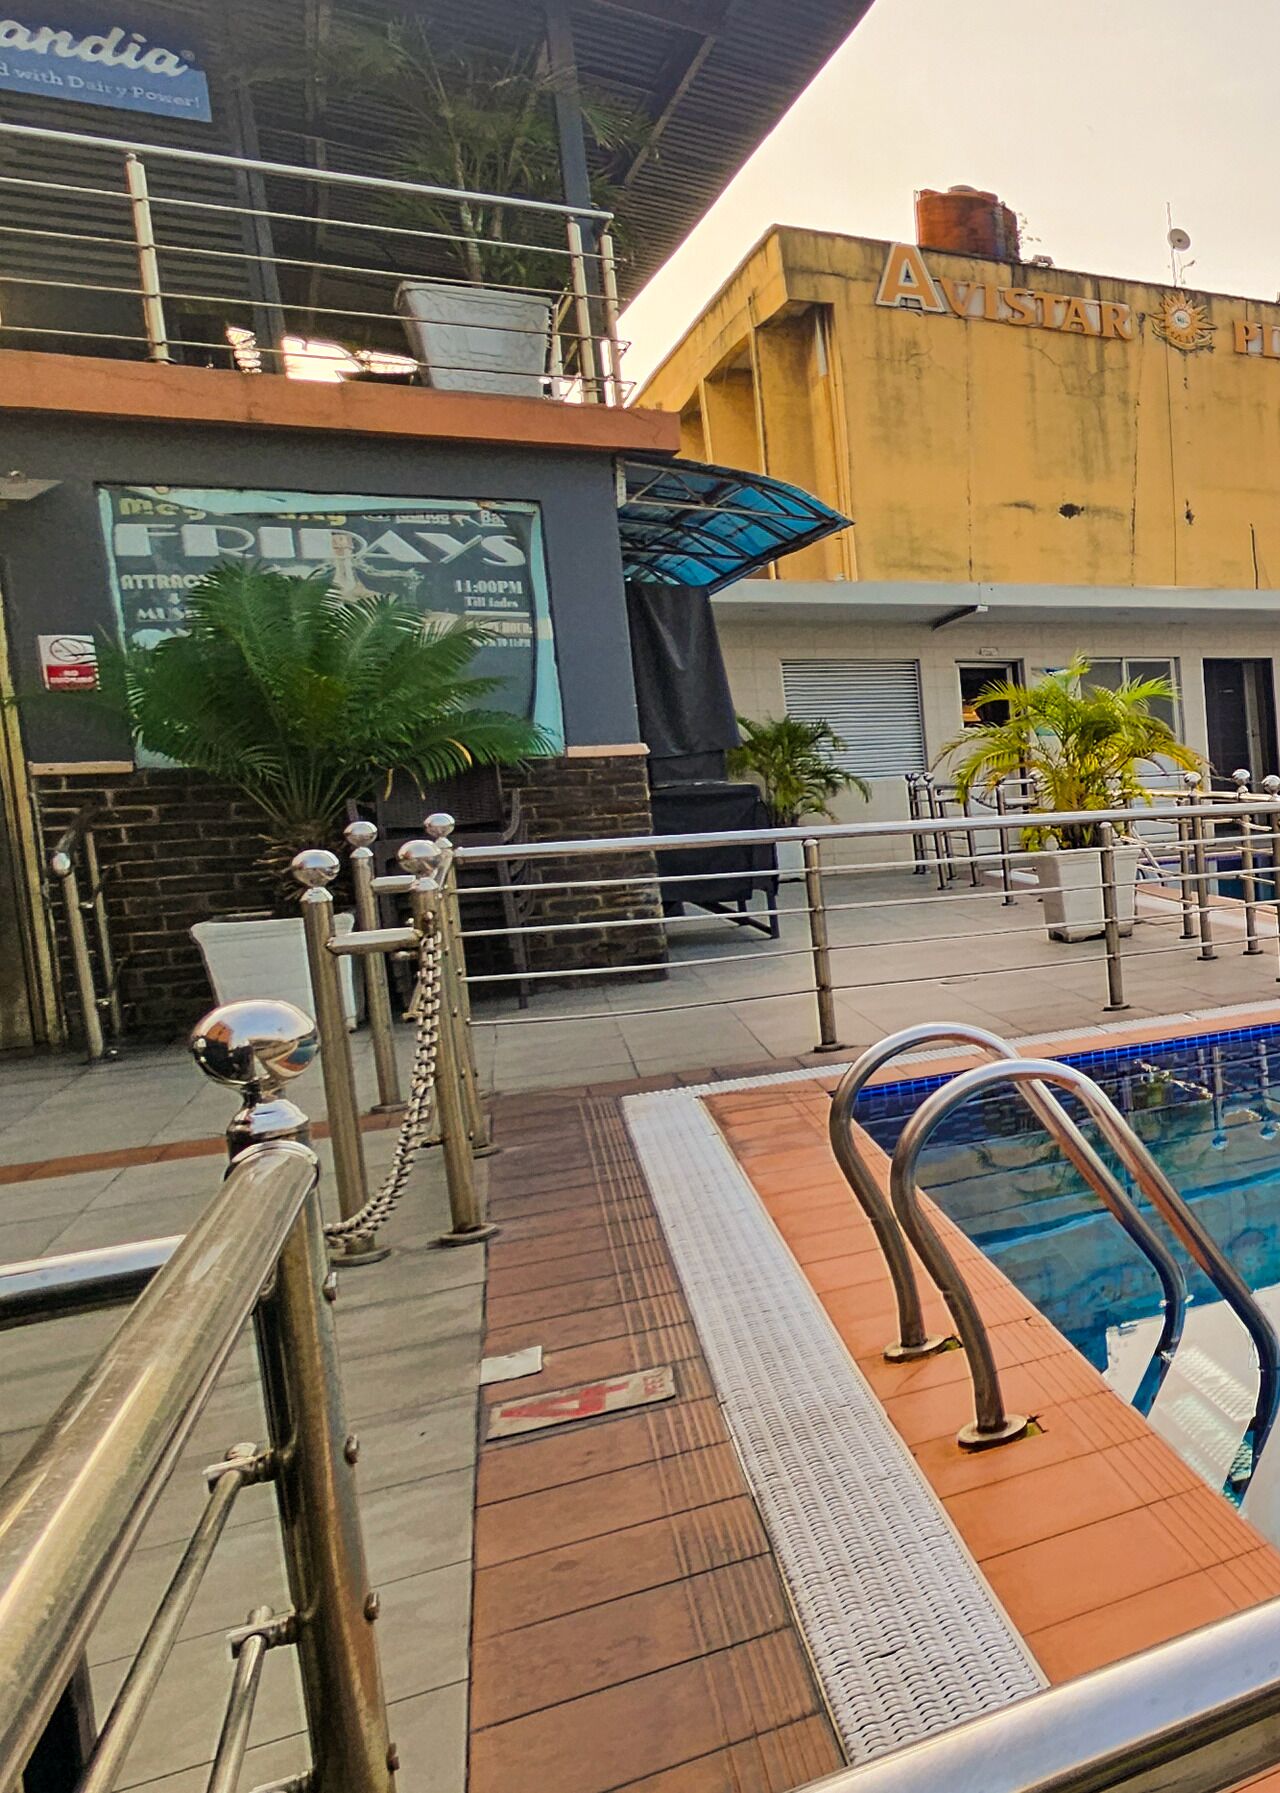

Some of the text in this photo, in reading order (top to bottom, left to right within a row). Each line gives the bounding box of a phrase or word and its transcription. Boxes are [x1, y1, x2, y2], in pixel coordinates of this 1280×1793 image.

[14, 65, 64, 86] with
[68, 75, 127, 99] Dairy
[131, 86, 200, 108] Power!
[876, 242, 1134, 340] AVISTAR
[114, 523, 526, 567] FRIDAYS
